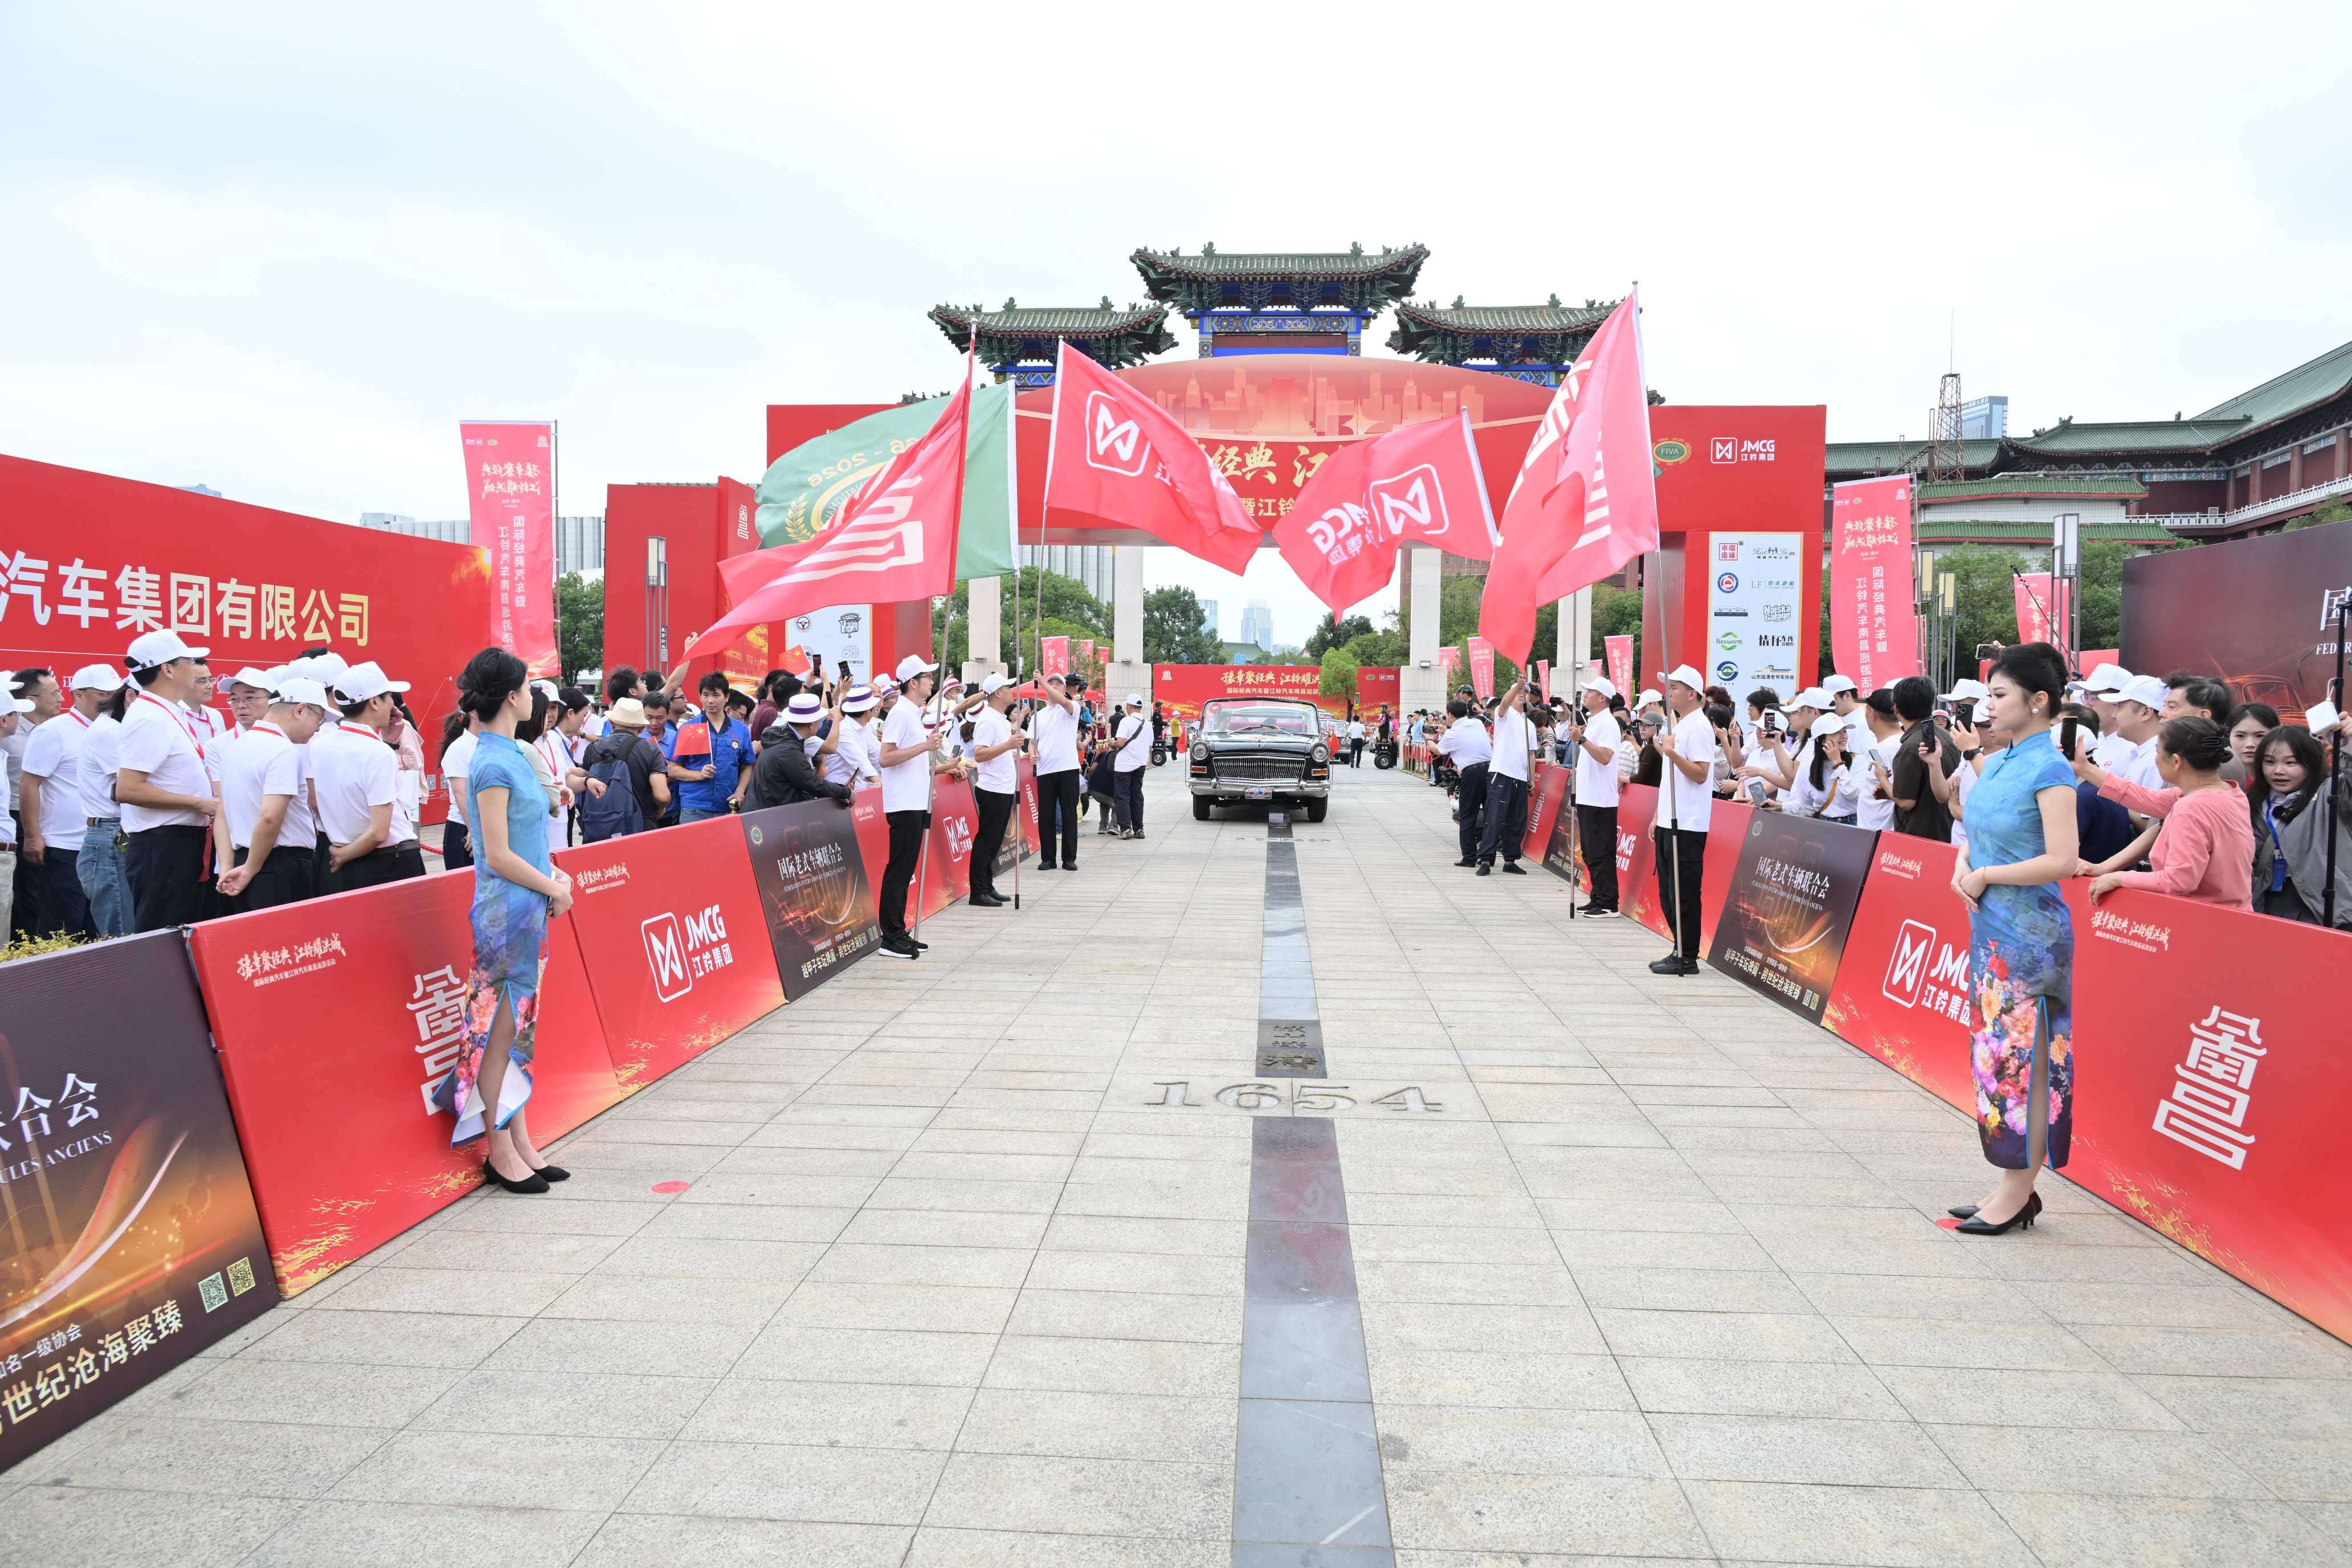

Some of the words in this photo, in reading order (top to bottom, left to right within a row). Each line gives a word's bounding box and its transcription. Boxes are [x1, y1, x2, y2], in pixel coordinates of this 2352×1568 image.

[1741, 440, 1775, 452] JMCG
[0, 550, 370, 646] 汽车集团有限公司
[2316, 642, 2352, 655] FEDR
[777, 842, 843, 880] 国际老式车辆联合会
[1755, 856, 1830, 899] 国际老式车辆联合会
[684, 904, 726, 952] JMCG
[237, 946, 292, 981] 豫章聚经典
[293, 932, 346, 963] 江铃耀洪城
[253, 958, 336, 987] 国际经典汽车暨江铃汽车南昌巡游活动
[691, 942, 733, 979] 江铃集团
[1930, 943, 1970, 993] JMC
[1921, 983, 1970, 1027] 江铃集团
[1145, 1081, 1442, 1112] 1654
[45, 1130, 113, 1167] ANCIENS
[0, 1299, 183, 1435] 世纪沧海聚臻
